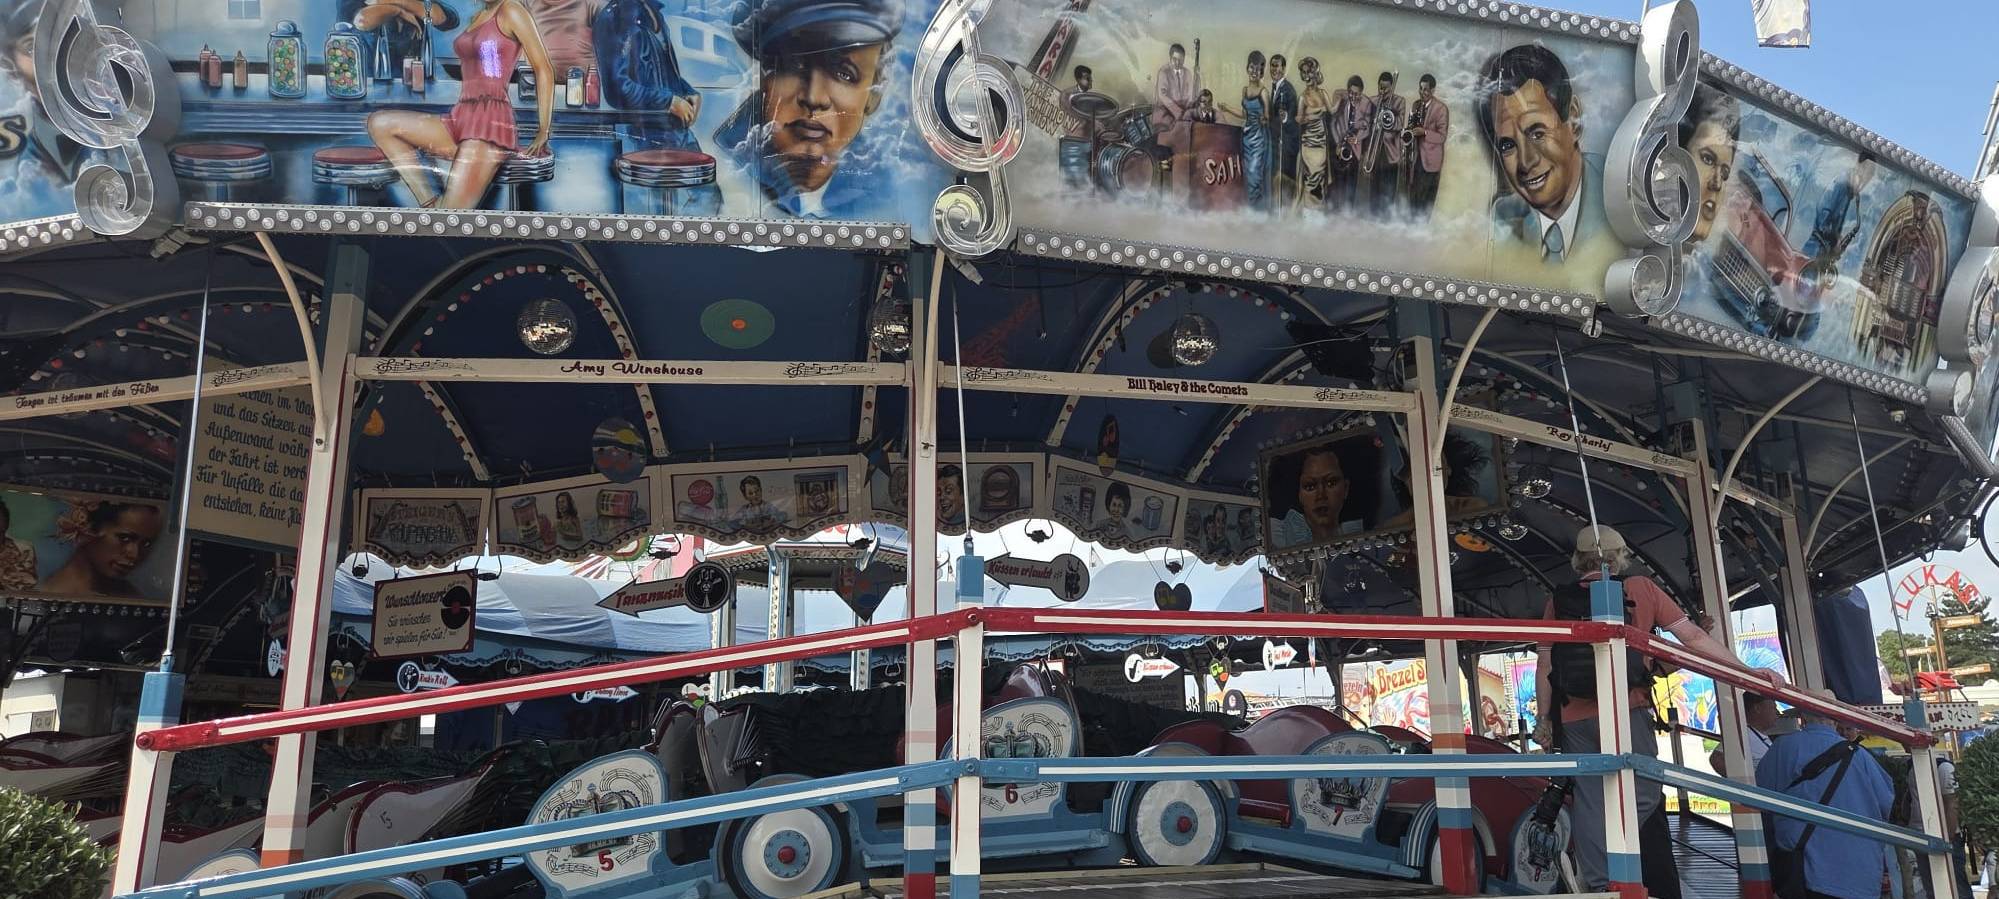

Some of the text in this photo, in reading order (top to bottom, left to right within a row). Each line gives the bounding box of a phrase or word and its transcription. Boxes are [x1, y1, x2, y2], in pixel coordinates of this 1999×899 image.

[561, 361, 704, 376] Amy Winehouse
[95, 388, 110, 400] mit
[111, 386, 126, 397] den
[130, 382, 160, 396] Füßen
[1127, 378, 1248, 396] Bill Haley & the Comets
[213, 403, 235, 417] und
[239, 406, 258, 422] das
[261, 410, 295, 433] Sitzen
[204, 421, 274, 451] Außenwand
[1546, 426, 1572, 442] Ray
[208, 446, 227, 462] der
[229, 448, 260, 470] Fahrt
[264, 455, 279, 474] ist
[196, 465, 217, 483] Für
[221, 470, 265, 495] Unfälle
[269, 481, 286, 497] die
[259, 501, 286, 521] keine
[1376, 664, 1415, 695] Brezel
[1005, 783, 1018, 804] 6
[1332, 805, 1345, 826] 7
[598, 849, 614, 872] 5
